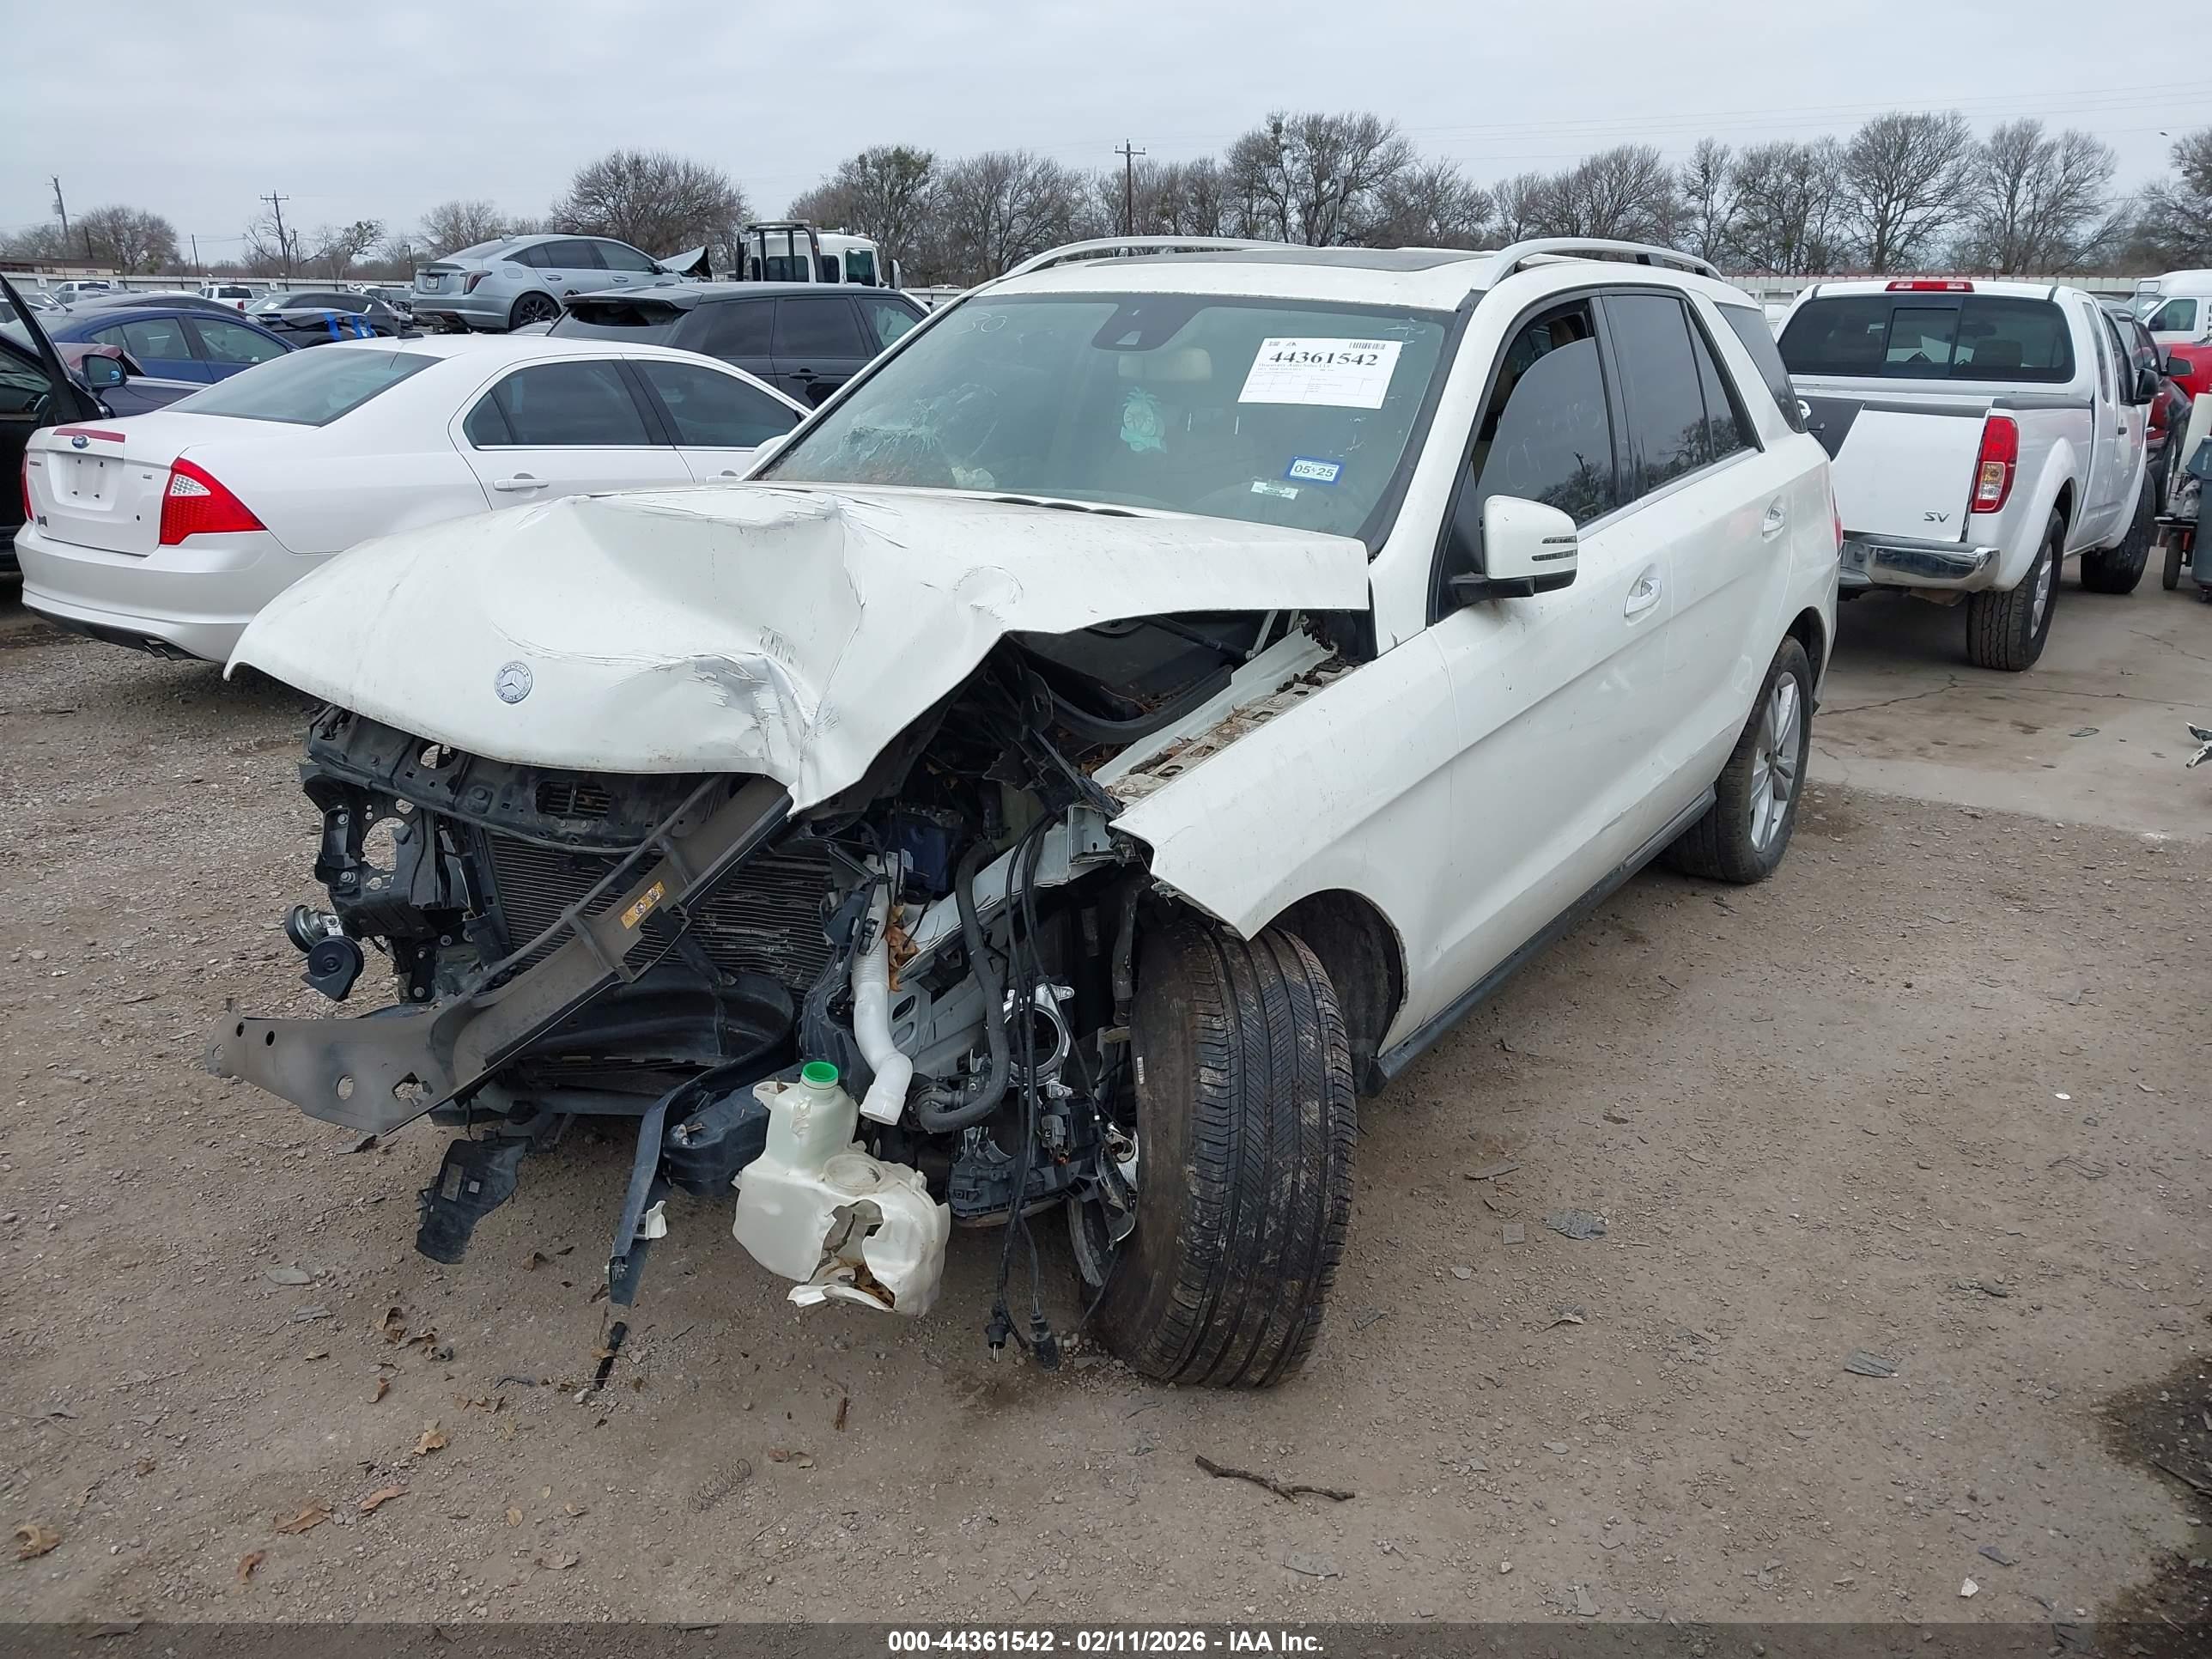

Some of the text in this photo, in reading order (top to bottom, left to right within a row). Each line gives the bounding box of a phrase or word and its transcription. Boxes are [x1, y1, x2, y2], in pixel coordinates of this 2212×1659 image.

[1268, 351, 1379, 366] 44361542
[1293, 465, 1335, 477] 05 25
[1923, 511, 1951, 523] SV
